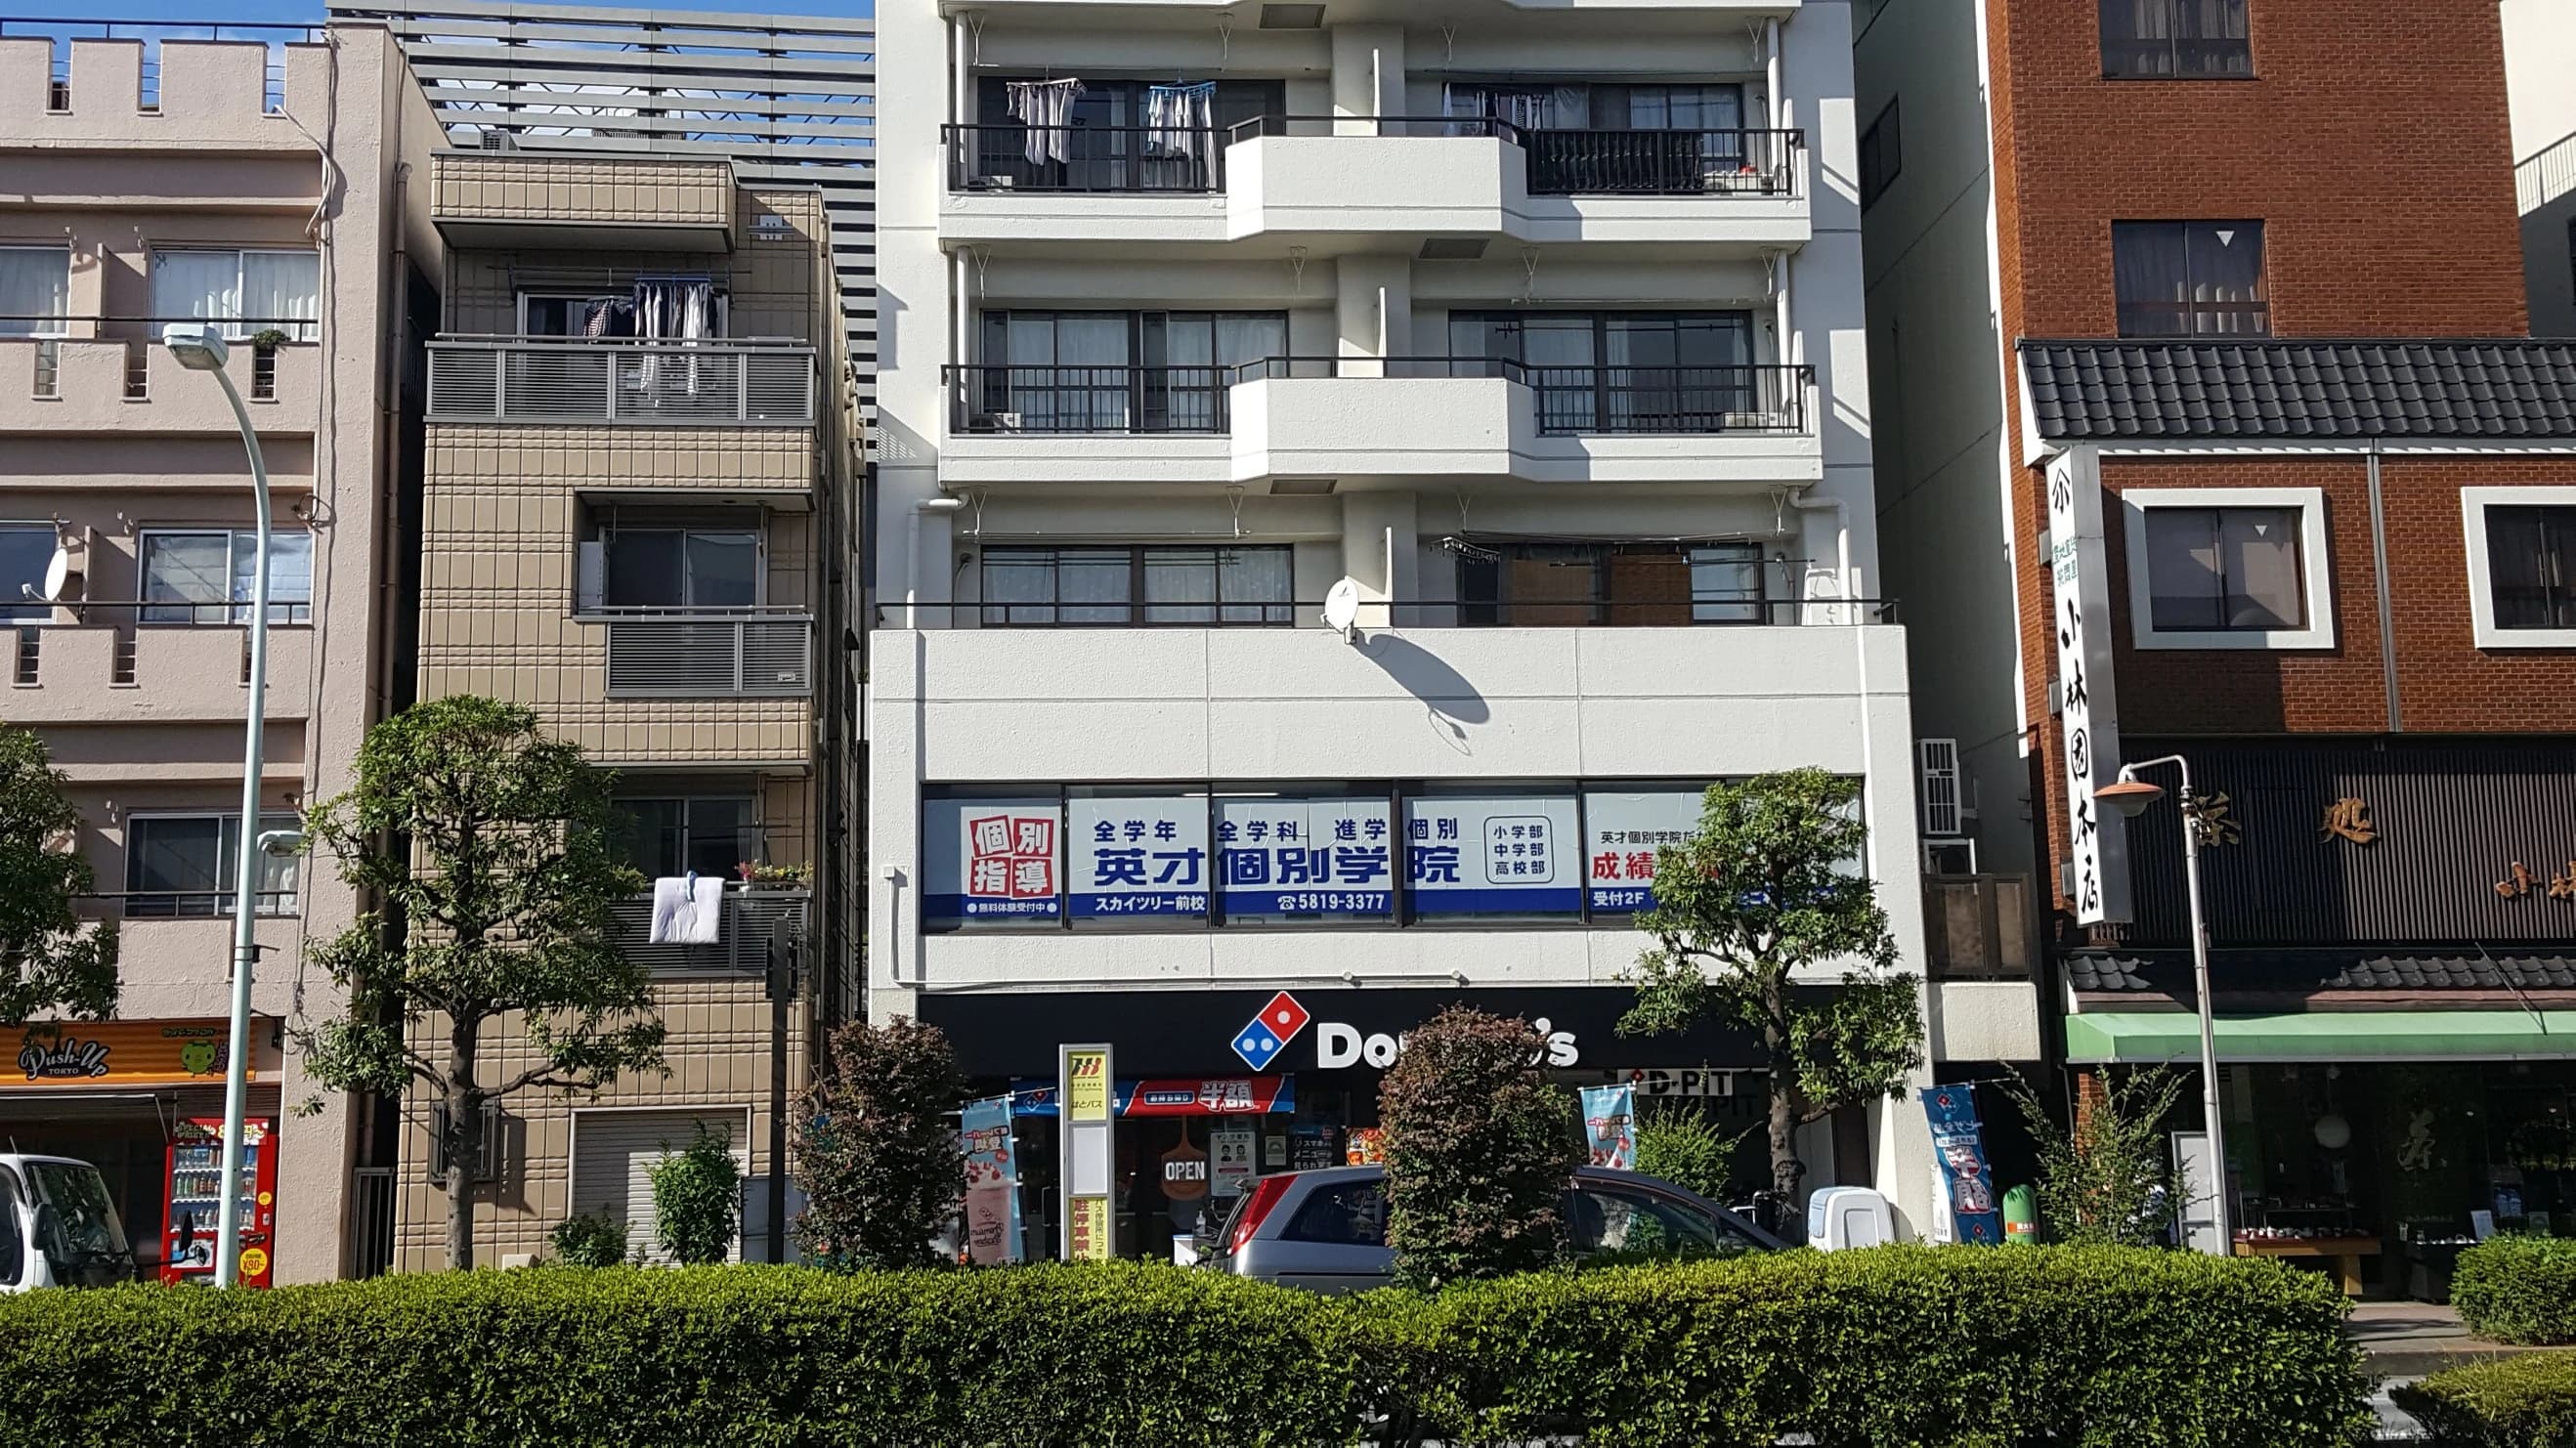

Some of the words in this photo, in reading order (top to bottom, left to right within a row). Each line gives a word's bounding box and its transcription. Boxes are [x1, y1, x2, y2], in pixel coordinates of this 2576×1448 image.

[974, 821, 1050, 855] 個別
[1095, 820, 1177, 841] 全学年
[1217, 820, 1298, 842] 全学科
[1334, 819, 1387, 841] 進学
[1407, 818, 1458, 840] 個別
[1493, 825, 1544, 839] 小学部
[1493, 842, 1544, 858] 中学部
[1494, 861, 1545, 875] 高校部
[974, 860, 1049, 894] 指導
[1095, 896, 1206, 912] スカイツリー前校
[1299, 894, 1385, 910] 5819-3377
[1593, 890, 1645, 907] 受付2F
[978, 903, 1046, 913] 無料体験受付中
[1317, 1017, 1579, 1070] Do's
[1199, 1080, 1255, 1111] 半額
[1071, 1100, 1102, 1109] はとバス
[1165, 1161, 1205, 1180] OPEN
